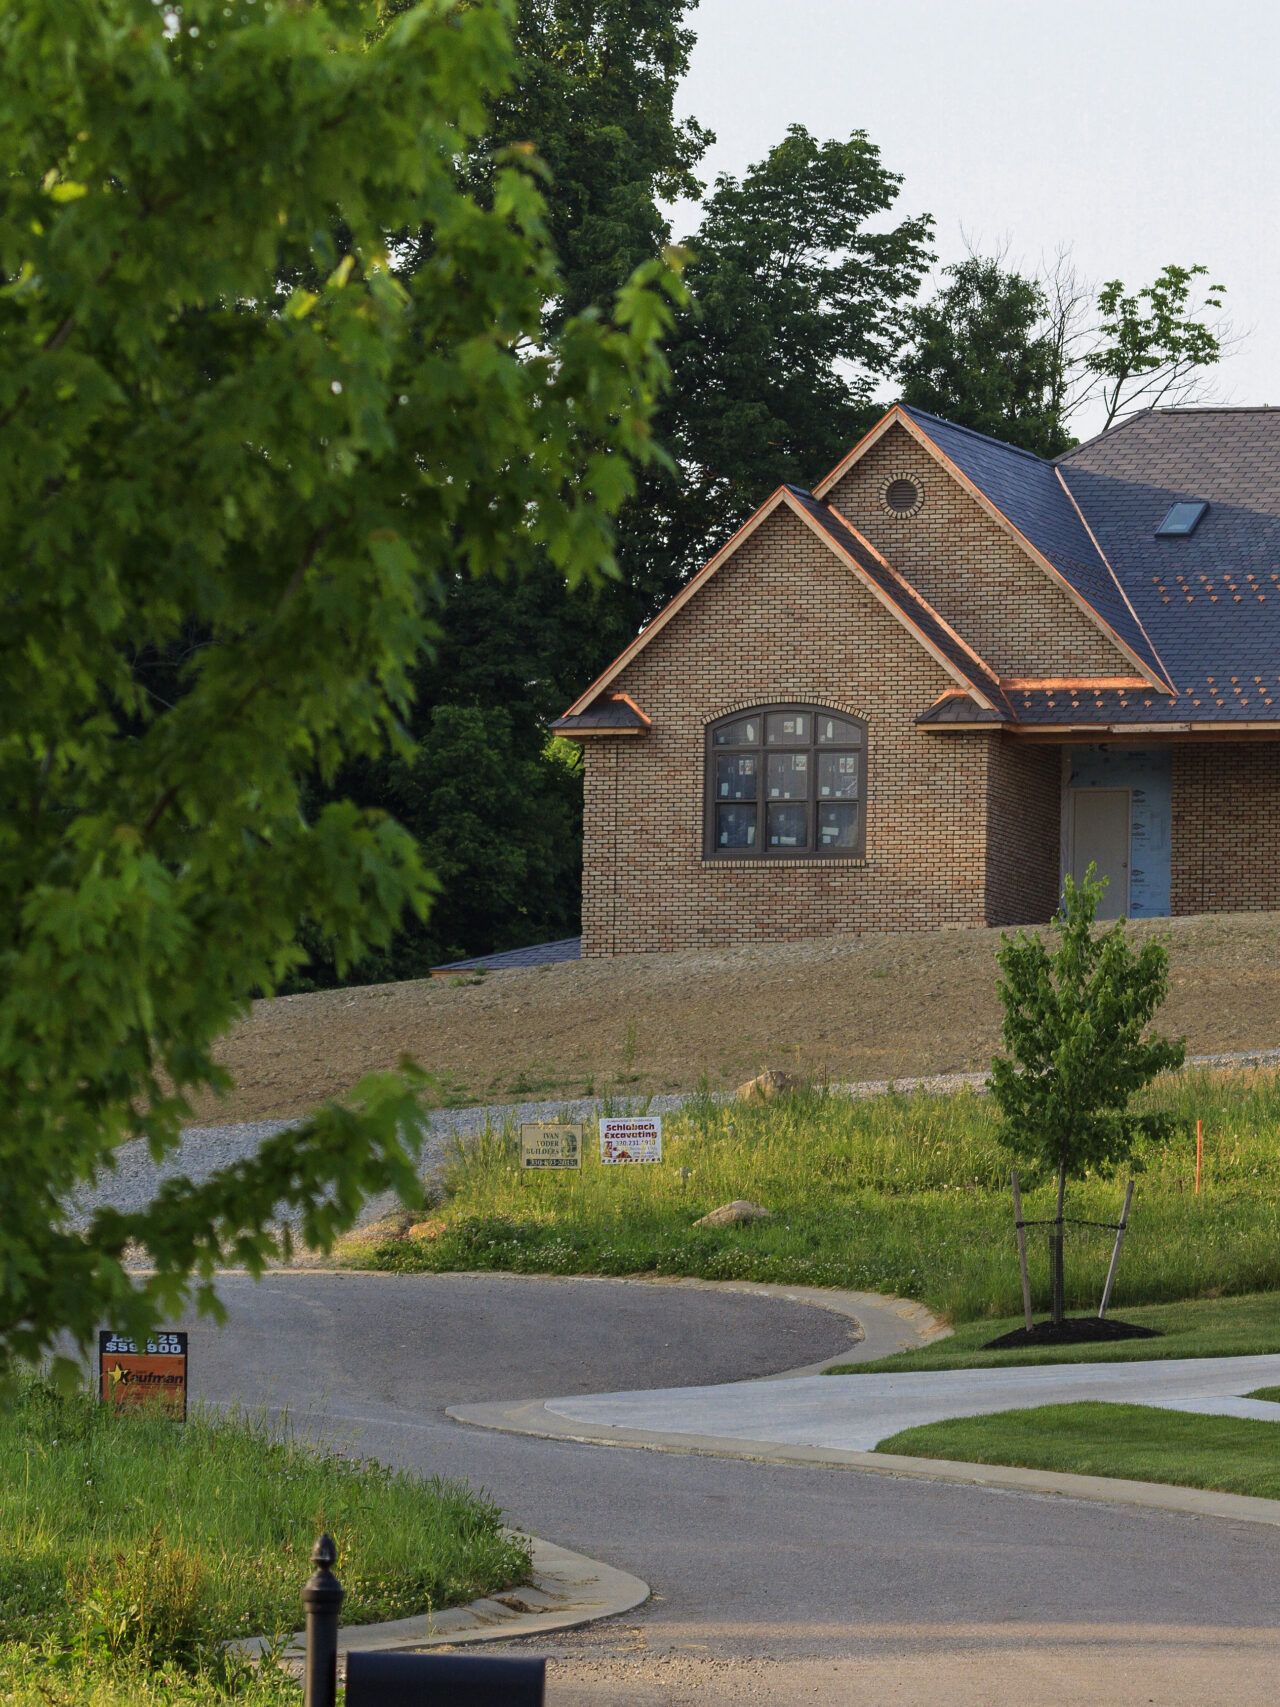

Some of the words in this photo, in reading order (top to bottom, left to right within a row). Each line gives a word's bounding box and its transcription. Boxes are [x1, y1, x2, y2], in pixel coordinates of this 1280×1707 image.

[604, 1131, 657, 1139] Excavating
[158, 1334, 178, 1344] 25
[119, 1369, 184, 1385] Kaufman
